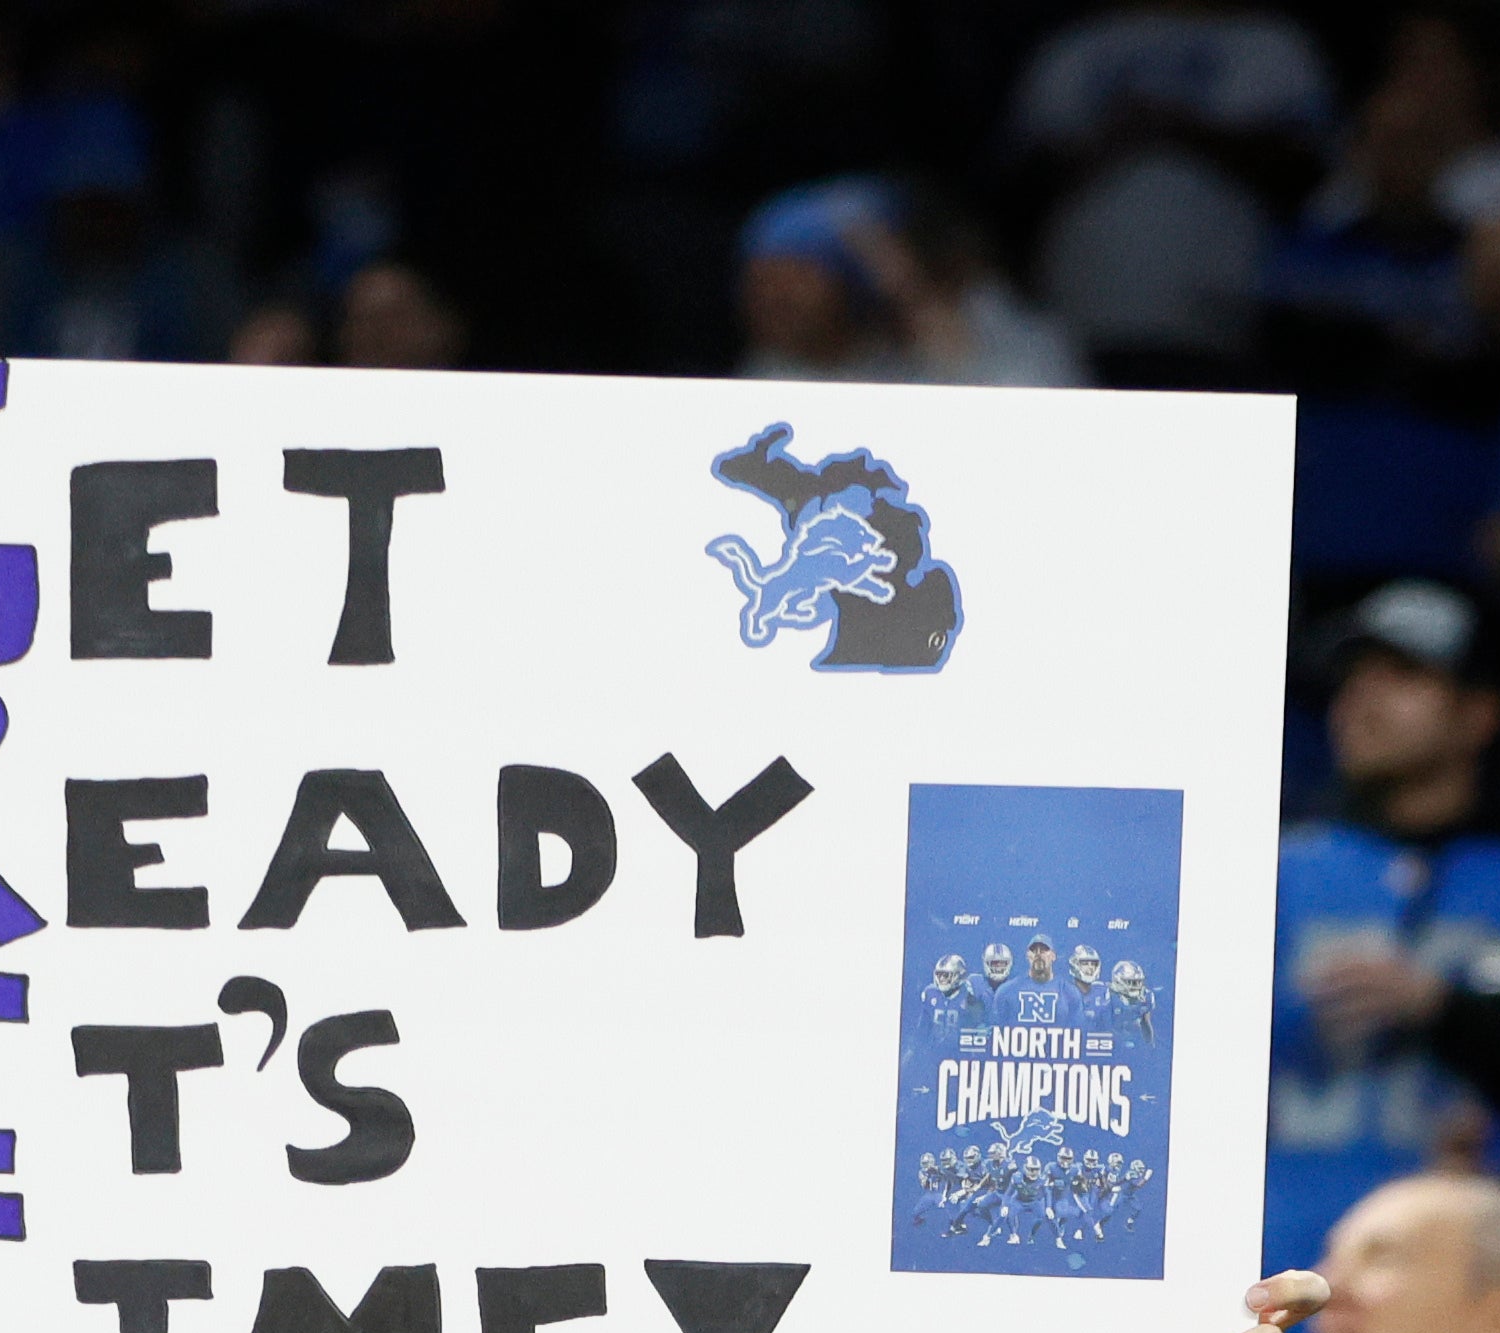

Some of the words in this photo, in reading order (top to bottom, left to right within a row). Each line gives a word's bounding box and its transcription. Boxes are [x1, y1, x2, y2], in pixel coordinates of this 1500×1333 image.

[959, 1034, 987, 1047] 20
[992, 1026, 1081, 1059] NORTH
[1085, 1039, 1113, 1051] 23
[936, 1059, 1132, 1138] CHAMPIONS
